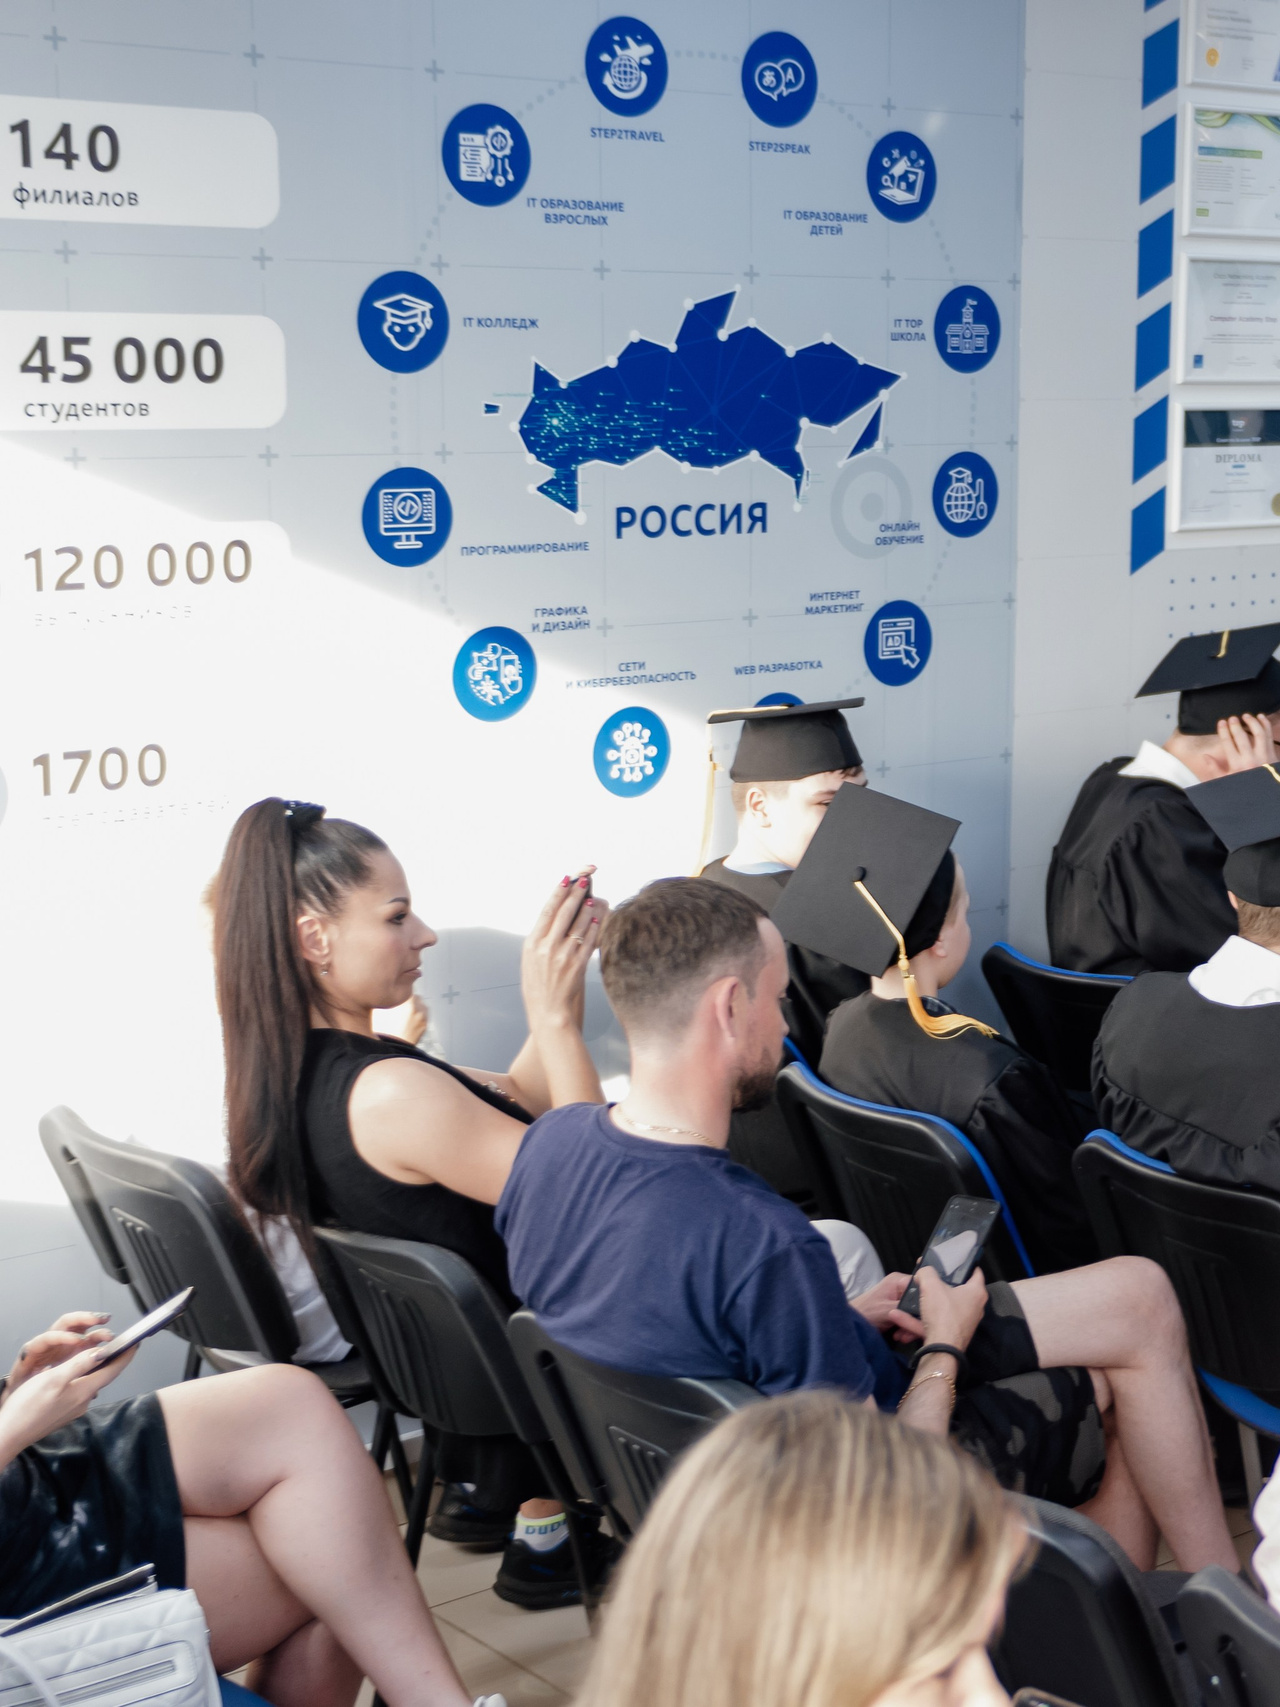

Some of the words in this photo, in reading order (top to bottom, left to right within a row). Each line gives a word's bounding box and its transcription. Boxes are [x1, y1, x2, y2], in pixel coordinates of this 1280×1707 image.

[590, 126, 666, 143] STEP2TRAVEL
[9, 119, 120, 173] 140
[748, 140, 811, 155] STEP2SPEAK
[13, 182, 140, 209] филиалов
[526, 197, 538, 209] IT
[540, 198, 625, 213] ОБРАЗОВАНИЕ
[544, 212, 609, 226] ВЗРОСЛЫХ
[783, 209, 793, 221] IT
[795, 210, 868, 224] ОБРАЗОВАНИЕ
[809, 224, 843, 237] ДЕТЕЙ
[463, 316, 474, 329] IT
[476, 317, 540, 331] КОЛЛЕДЖ
[893, 318, 903, 328] IT
[890, 331, 927, 342] ШКОЛА
[19, 335, 92, 384] 45
[113, 336, 224, 384] 000
[24, 402, 150, 424] студентов
[1215, 454, 1263, 464] DIPLOMA
[615, 501, 769, 540] РОССИЯ
[879, 520, 921, 533] ОНЛАЙН
[874, 534, 925, 546] ОБУЧЕНИЕ
[460, 541, 590, 557] ПРОГРАММИРОВАНИЕ
[24, 544, 124, 592] 120
[147, 539, 252, 587] 000
[809, 590, 861, 602] ИНТЕРНЕТ
[534, 605, 588, 619] ГРАФИКА
[805, 602, 865, 616] МАРКЕТИНГ
[531, 623, 540, 633] И
[542, 617, 591, 634] ДИЗАЙН
[618, 661, 646, 673] СЕТИ
[734, 665, 756, 676] WEB
[758, 660, 823, 674] РАЗРАБОТКА
[576, 670, 697, 690] КИБЕРБЕЗОПАСНОСТЬ
[32, 743, 167, 797] 1700
